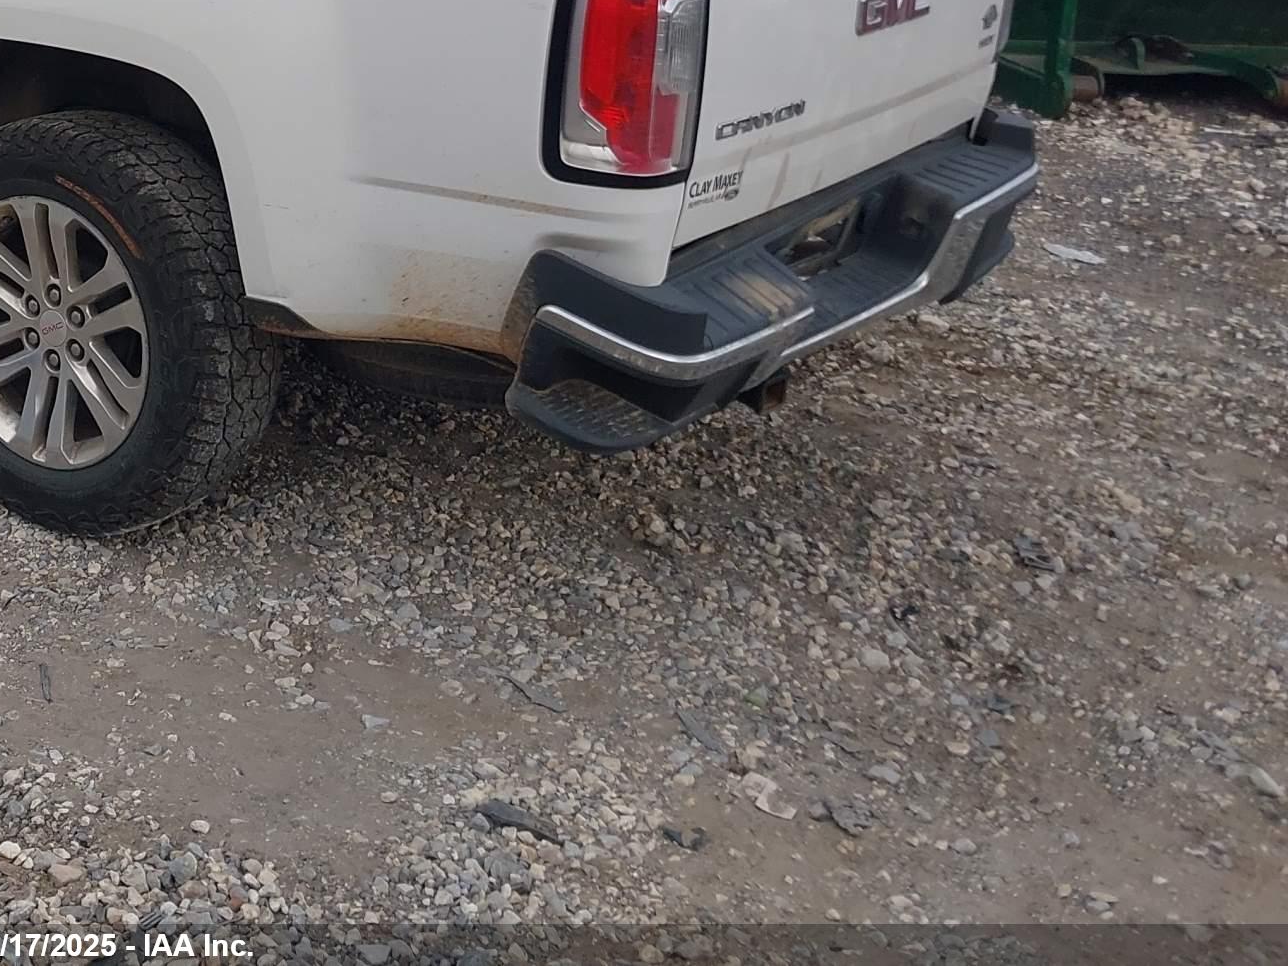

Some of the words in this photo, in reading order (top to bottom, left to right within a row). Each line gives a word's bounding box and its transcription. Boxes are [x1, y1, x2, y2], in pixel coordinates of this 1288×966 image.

[715, 99, 805, 141] CANYON
[689, 180, 712, 198] CLAY
[712, 170, 743, 192] MAXEY
[42, 321, 64, 335] GMC
